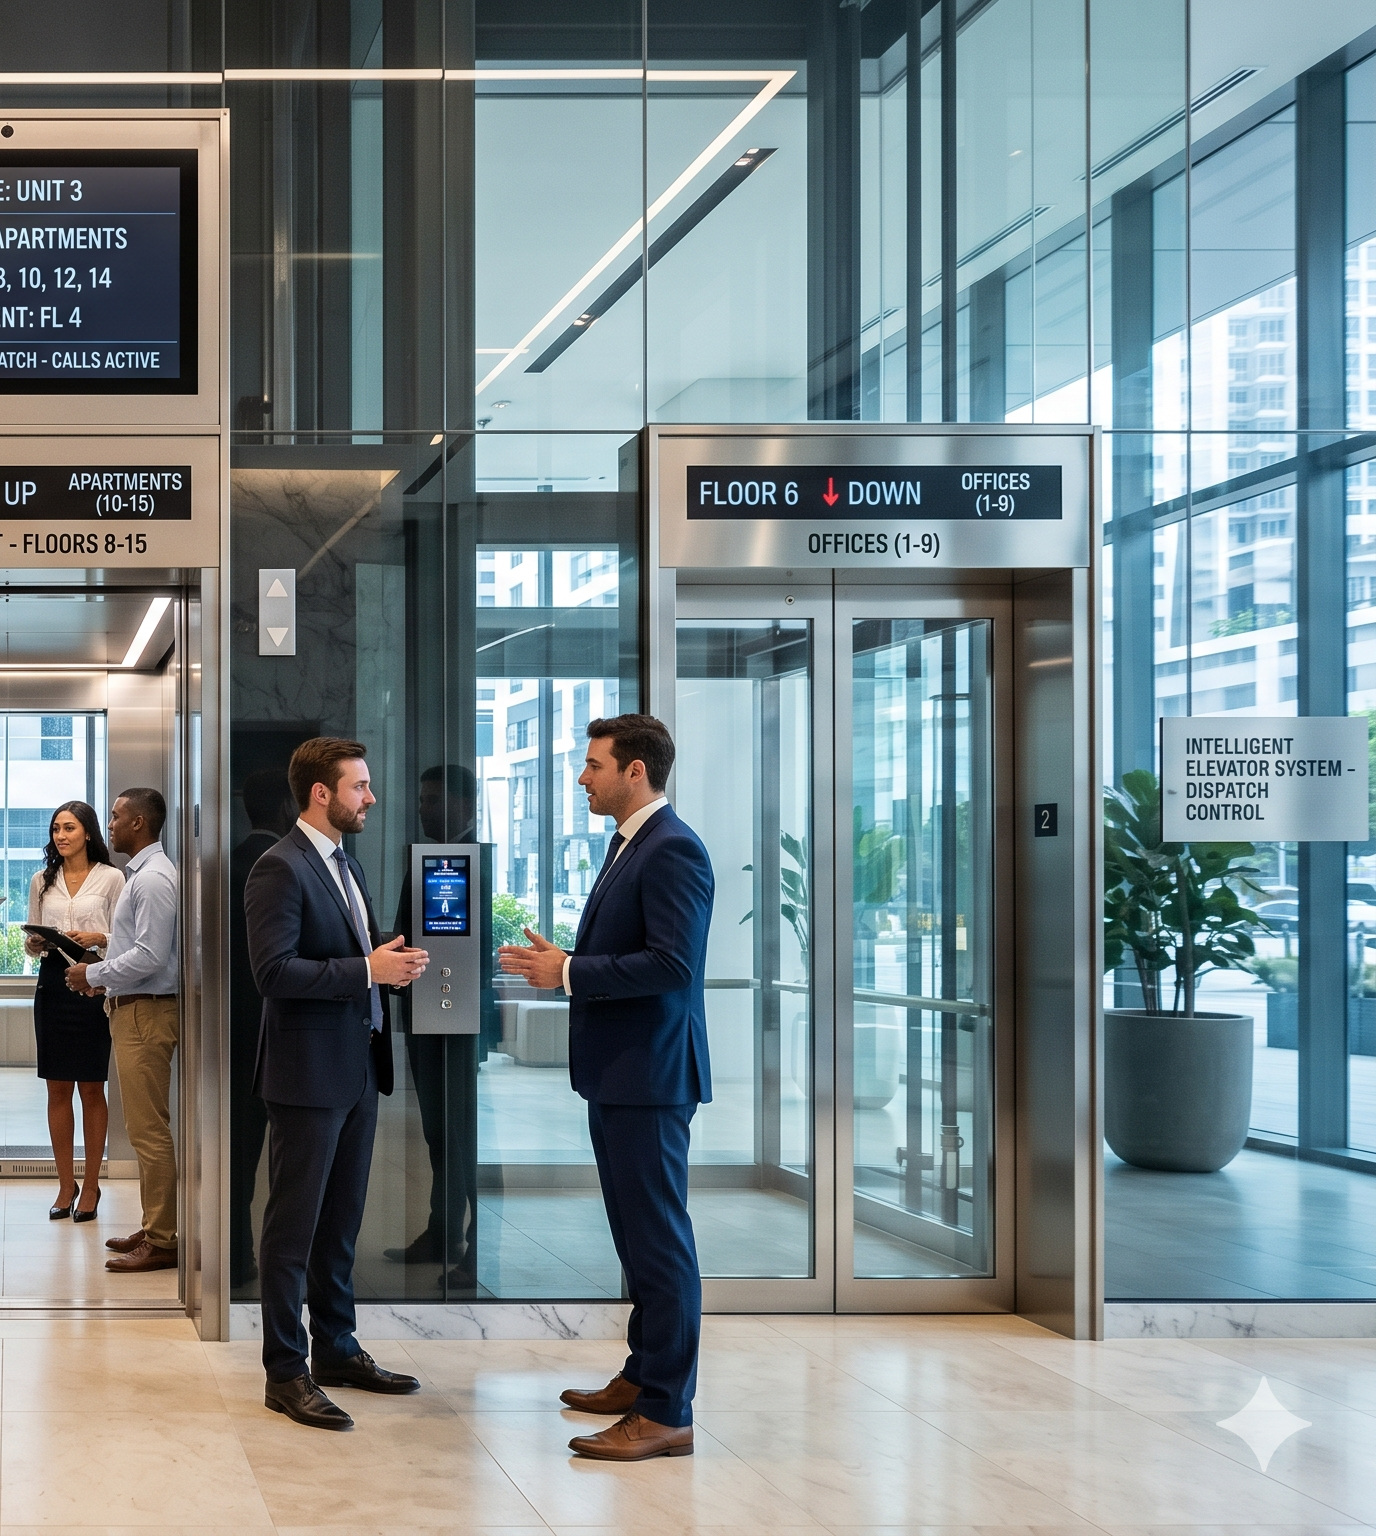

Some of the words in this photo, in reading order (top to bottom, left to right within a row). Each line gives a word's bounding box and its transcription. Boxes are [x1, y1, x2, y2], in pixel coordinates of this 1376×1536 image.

[17, 179, 65, 202] UNIT
[70, 179, 83, 202] 3
[18, 266, 46, 293] 10,
[53, 266, 82, 293] 12,
[88, 266, 112, 289] 14
[40, 306, 64, 328] FL
[68, 306, 82, 328] 4
[51, 351, 101, 369] CALLS
[104, 351, 160, 369] ACTIVE
[68, 472, 183, 491] APARTMENTS
[961, 472, 1031, 491] OFFICES
[4, 480, 37, 506] UP
[700, 481, 777, 506] FLOOR
[784, 481, 799, 506] 6
[848, 481, 921, 506] DOWN
[96, 493, 155, 518] (10-15)
[975, 493, 1015, 518] (1-9)
[23, 533, 99, 554] FLOORS
[104, 533, 147, 554] 8-15
[808, 533, 888, 554] OFFICES
[894, 532, 940, 559] (1-9)
[1186, 737, 1294, 755] INTELLIGENT
[1186, 759, 1270, 777] ELEVATOR
[1275, 759, 1342, 777] SYSTEM
[1186, 781, 1269, 799] DISPATCH
[1041, 809, 1050, 829] 2
[1186, 803, 1265, 821] CONTROL
